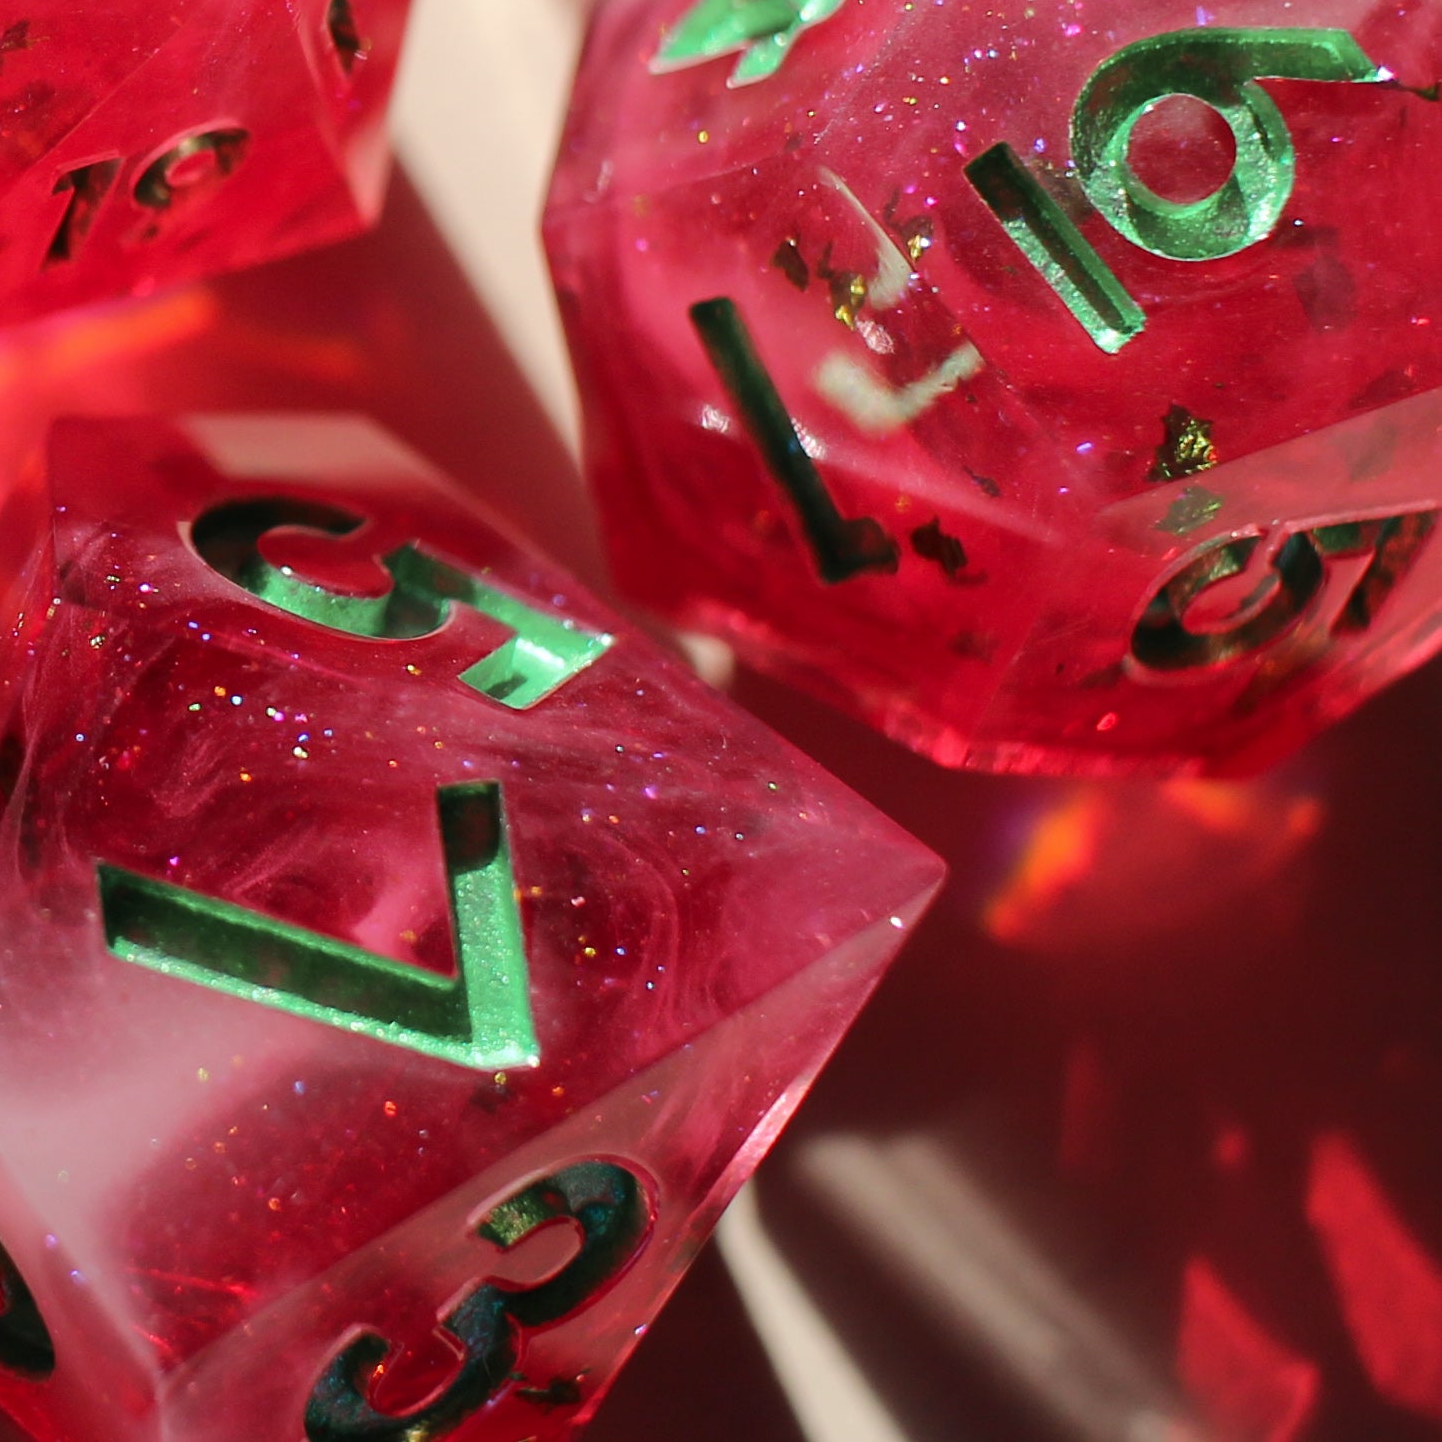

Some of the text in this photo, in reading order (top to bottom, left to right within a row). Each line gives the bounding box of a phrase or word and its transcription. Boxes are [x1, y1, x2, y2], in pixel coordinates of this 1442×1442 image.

[188, 494, 615, 711] 5
[97, 780, 542, 1070] 7
[303, 1160, 653, 1442] 3
